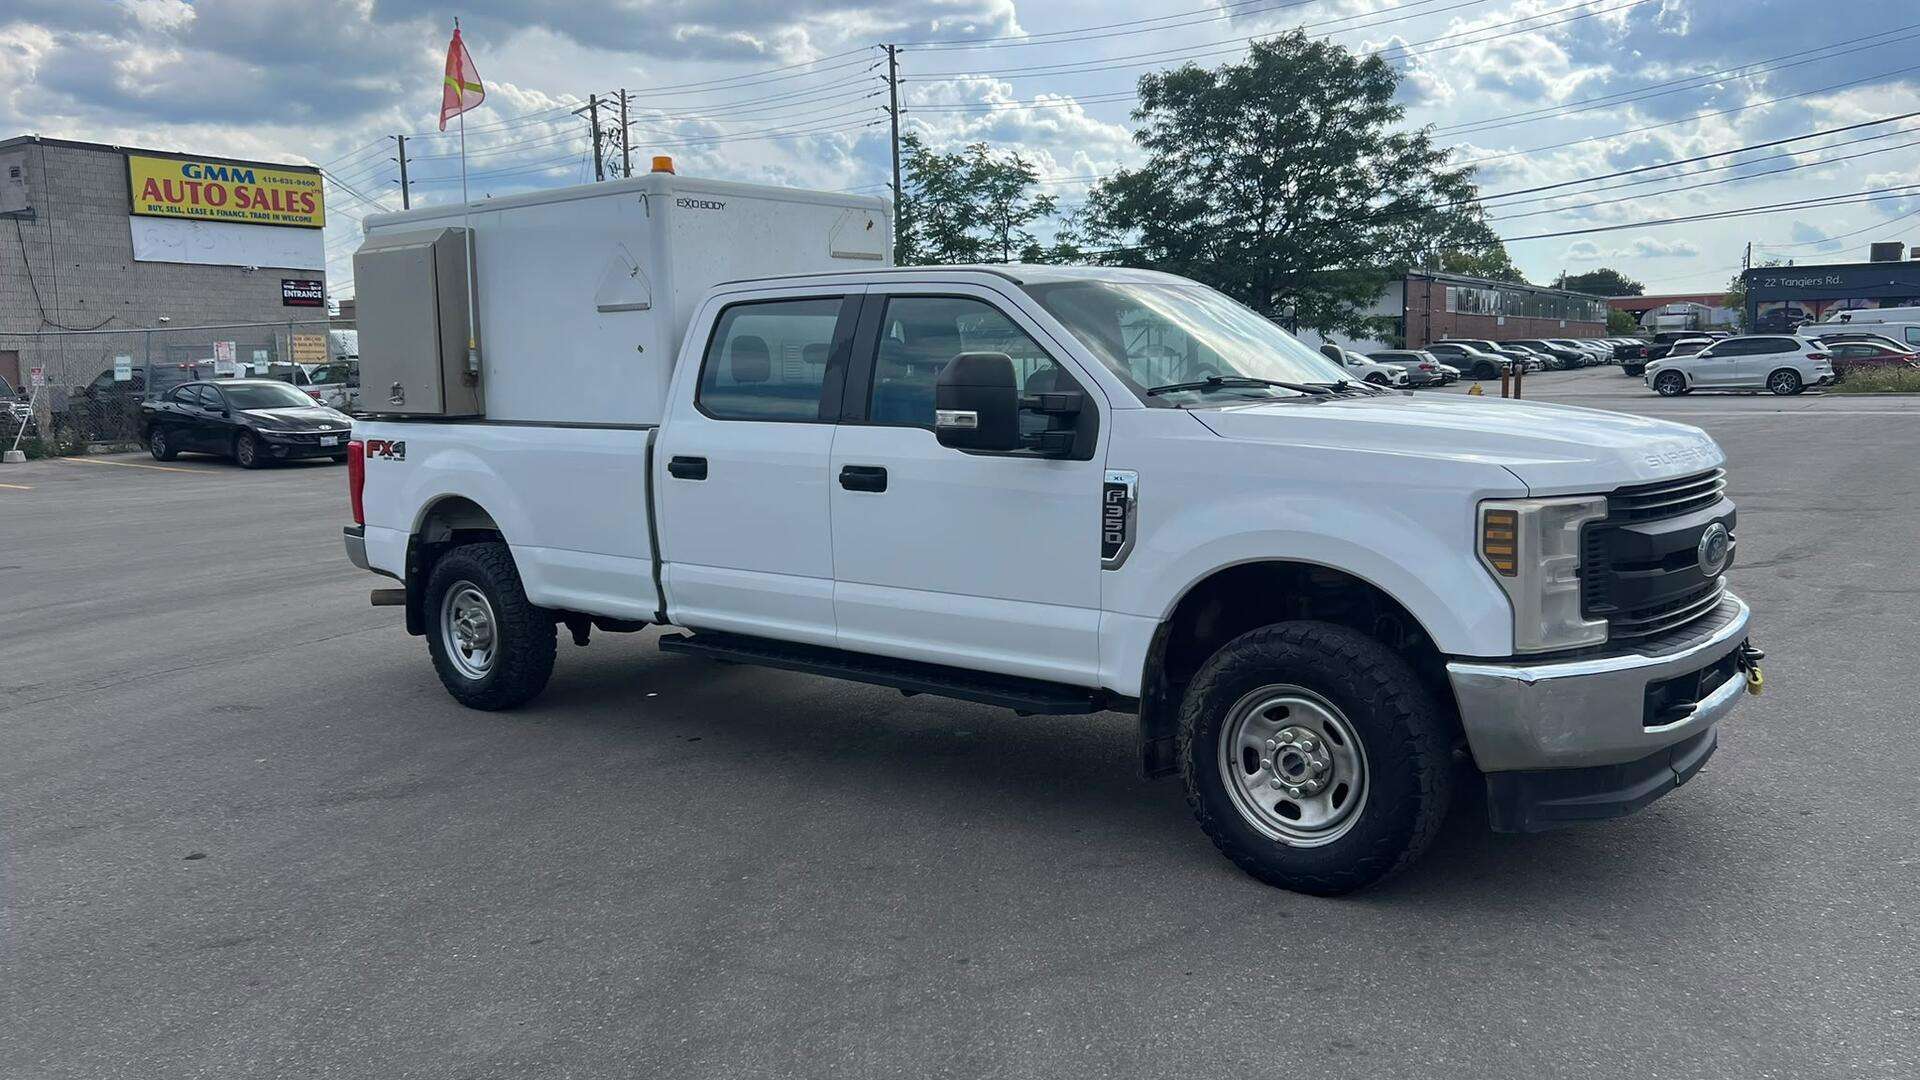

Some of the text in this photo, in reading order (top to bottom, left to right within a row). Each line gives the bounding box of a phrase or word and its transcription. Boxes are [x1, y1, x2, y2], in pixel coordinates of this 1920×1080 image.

[182, 163, 255, 184] GMM
[142, 177, 316, 214] AUTO SALES
[187, 207, 208, 216] LEASE
[209, 208, 215, 216] &
[250, 211, 270, 220] TRADE
[272, 213, 281, 221] IN
[281, 214, 312, 223] WELCOME
[1764, 275, 1844, 288] 22 Tangiers Rd.
[283, 289, 322, 299] ENTRANCE
[366, 439, 406, 458] FX4
